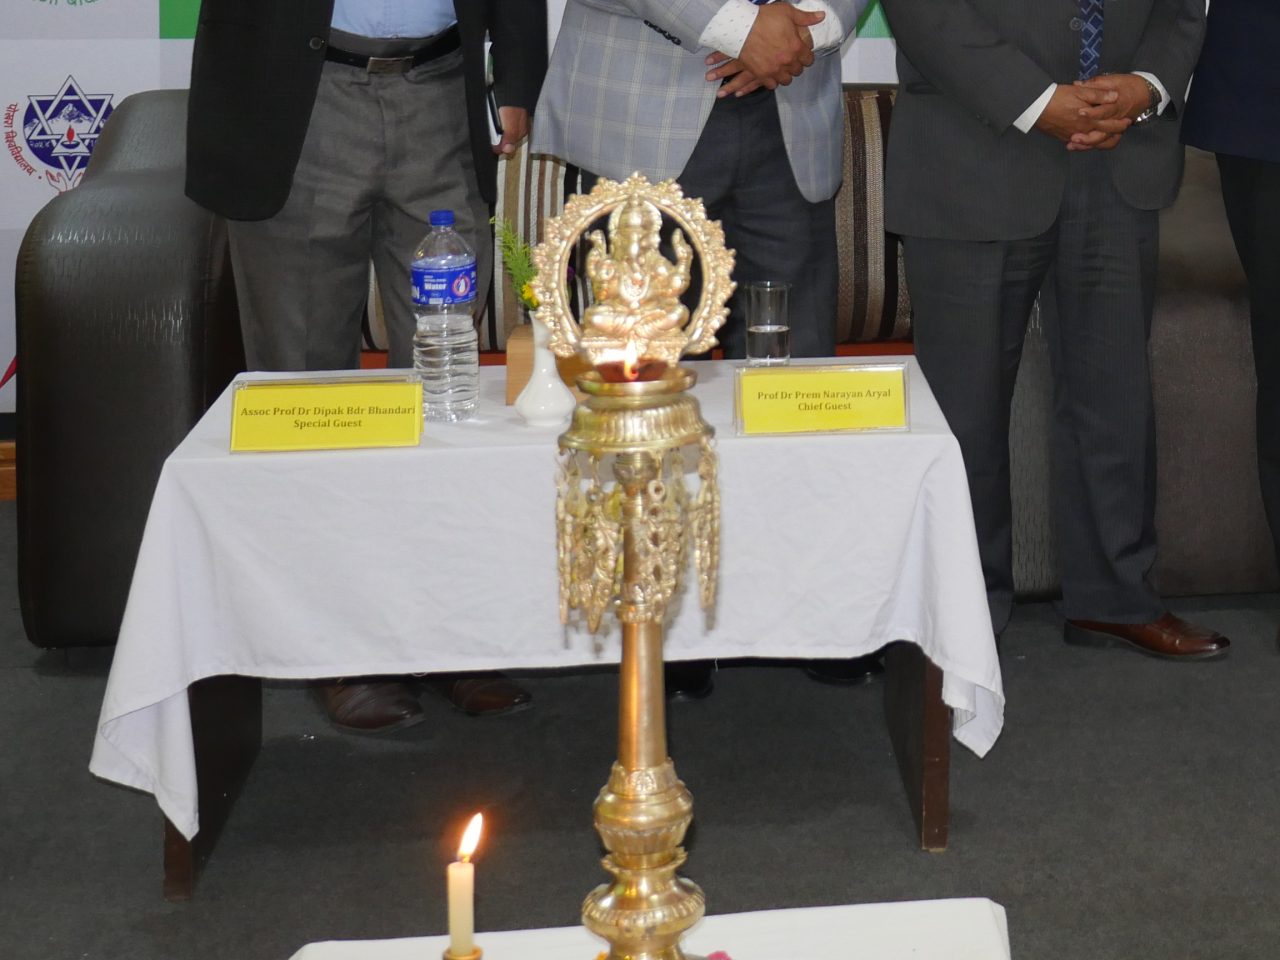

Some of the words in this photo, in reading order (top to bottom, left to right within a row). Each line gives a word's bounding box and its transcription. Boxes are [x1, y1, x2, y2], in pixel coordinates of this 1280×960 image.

[758, 390, 779, 400] Prof
[781, 391, 793, 400] Dr
[795, 390, 821, 399] Prem
[823, 390, 863, 401] Narayan
[865, 388, 891, 400] Aryal
[240, 407, 270, 416] Assoc
[273, 406, 297, 416] Prof
[298, 407, 311, 416] Dr
[313, 406, 344, 417] Dipak
[347, 405, 365, 415] Bdr
[368, 405, 416, 415] Bhandari
[798, 401, 823, 411] Chief
[824, 401, 852, 411] Guest
[293, 418, 331, 430] Special
[333, 418, 362, 428] Guest
